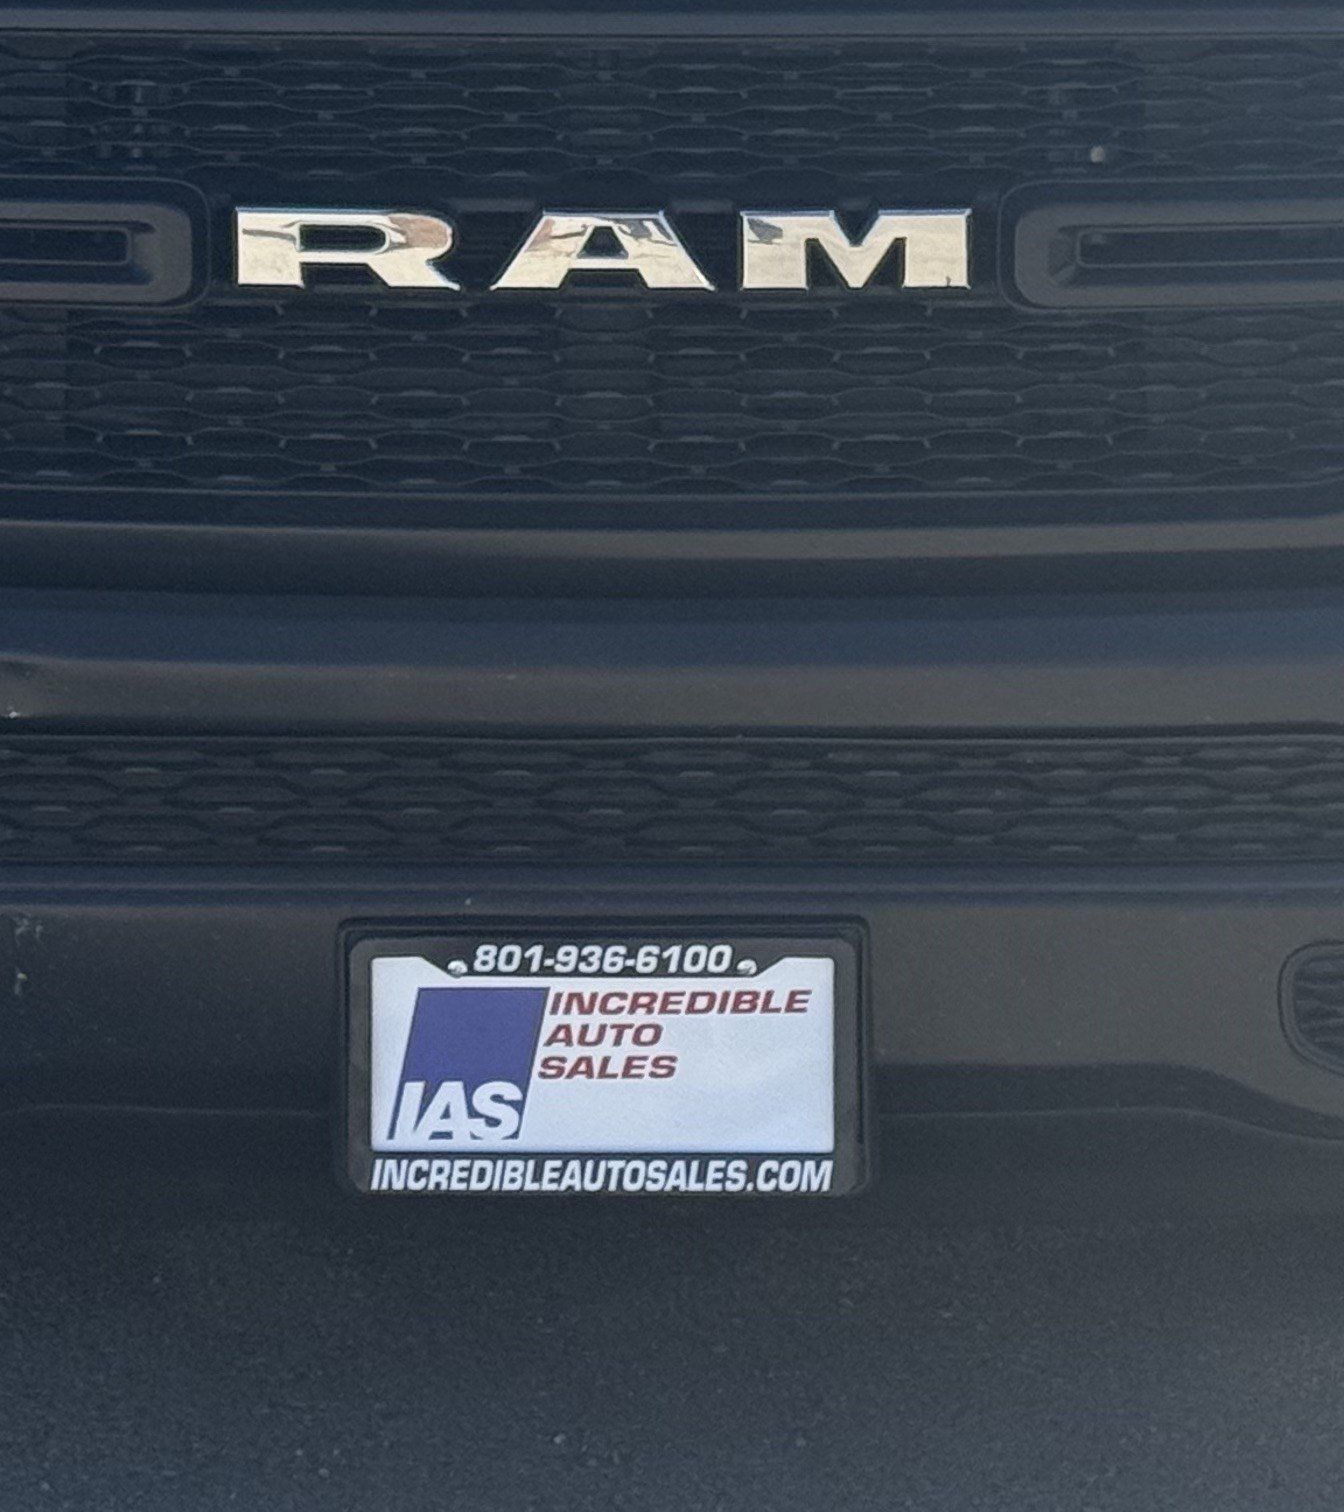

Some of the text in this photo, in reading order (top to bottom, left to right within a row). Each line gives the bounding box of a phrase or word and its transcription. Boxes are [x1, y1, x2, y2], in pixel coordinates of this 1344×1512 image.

[235, 206, 972, 291] RAM
[473, 944, 733, 974] 801-936-6100
[549, 990, 812, 1016] INCREDIBLE
[543, 1023, 663, 1048] AUTO
[538, 1055, 678, 1080] SALES
[393, 1080, 523, 1141] IAS
[370, 1159, 833, 1192] INCREDIBLEAUTOSALES.COM
